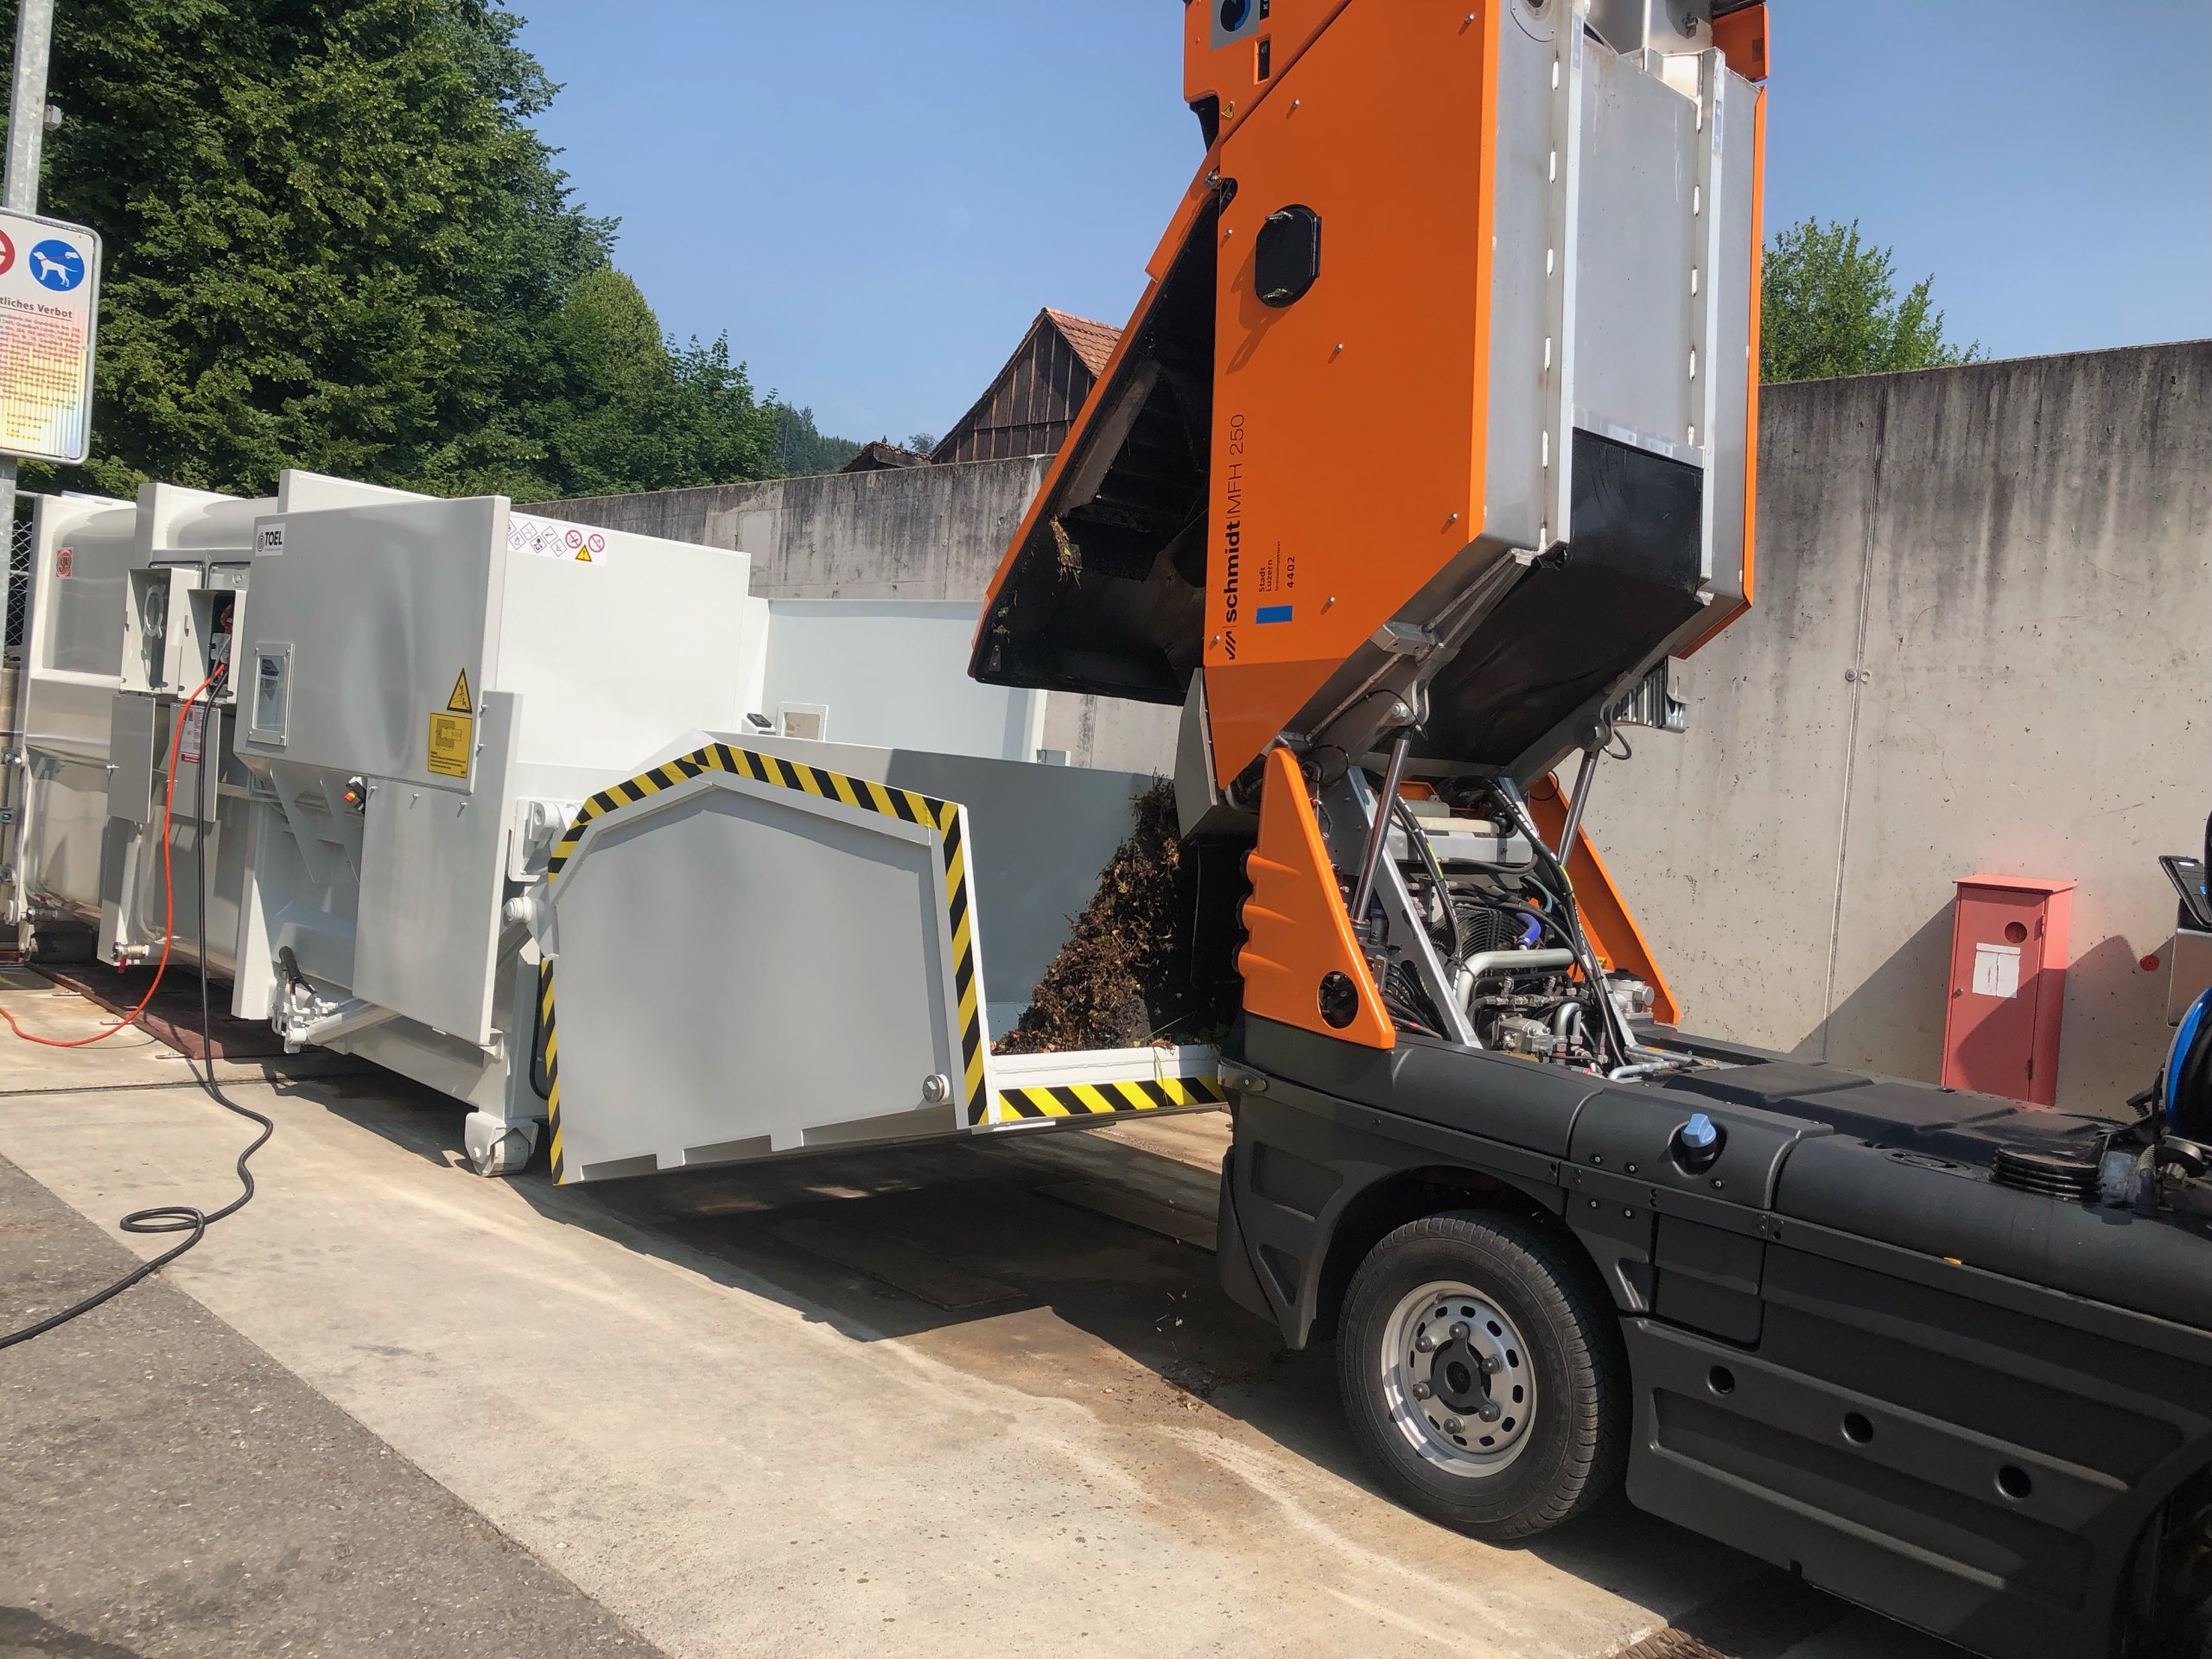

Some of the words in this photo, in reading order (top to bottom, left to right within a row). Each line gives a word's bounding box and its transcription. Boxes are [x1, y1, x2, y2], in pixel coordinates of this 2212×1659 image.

[37, 303, 73, 319] Verbot
[1229, 414, 1244, 455] 250
[1227, 463, 1243, 514] MFH
[265, 531, 283, 546] TOEL
[1223, 520, 1241, 623] schmidt
[1286, 556, 1295, 588] 4402
